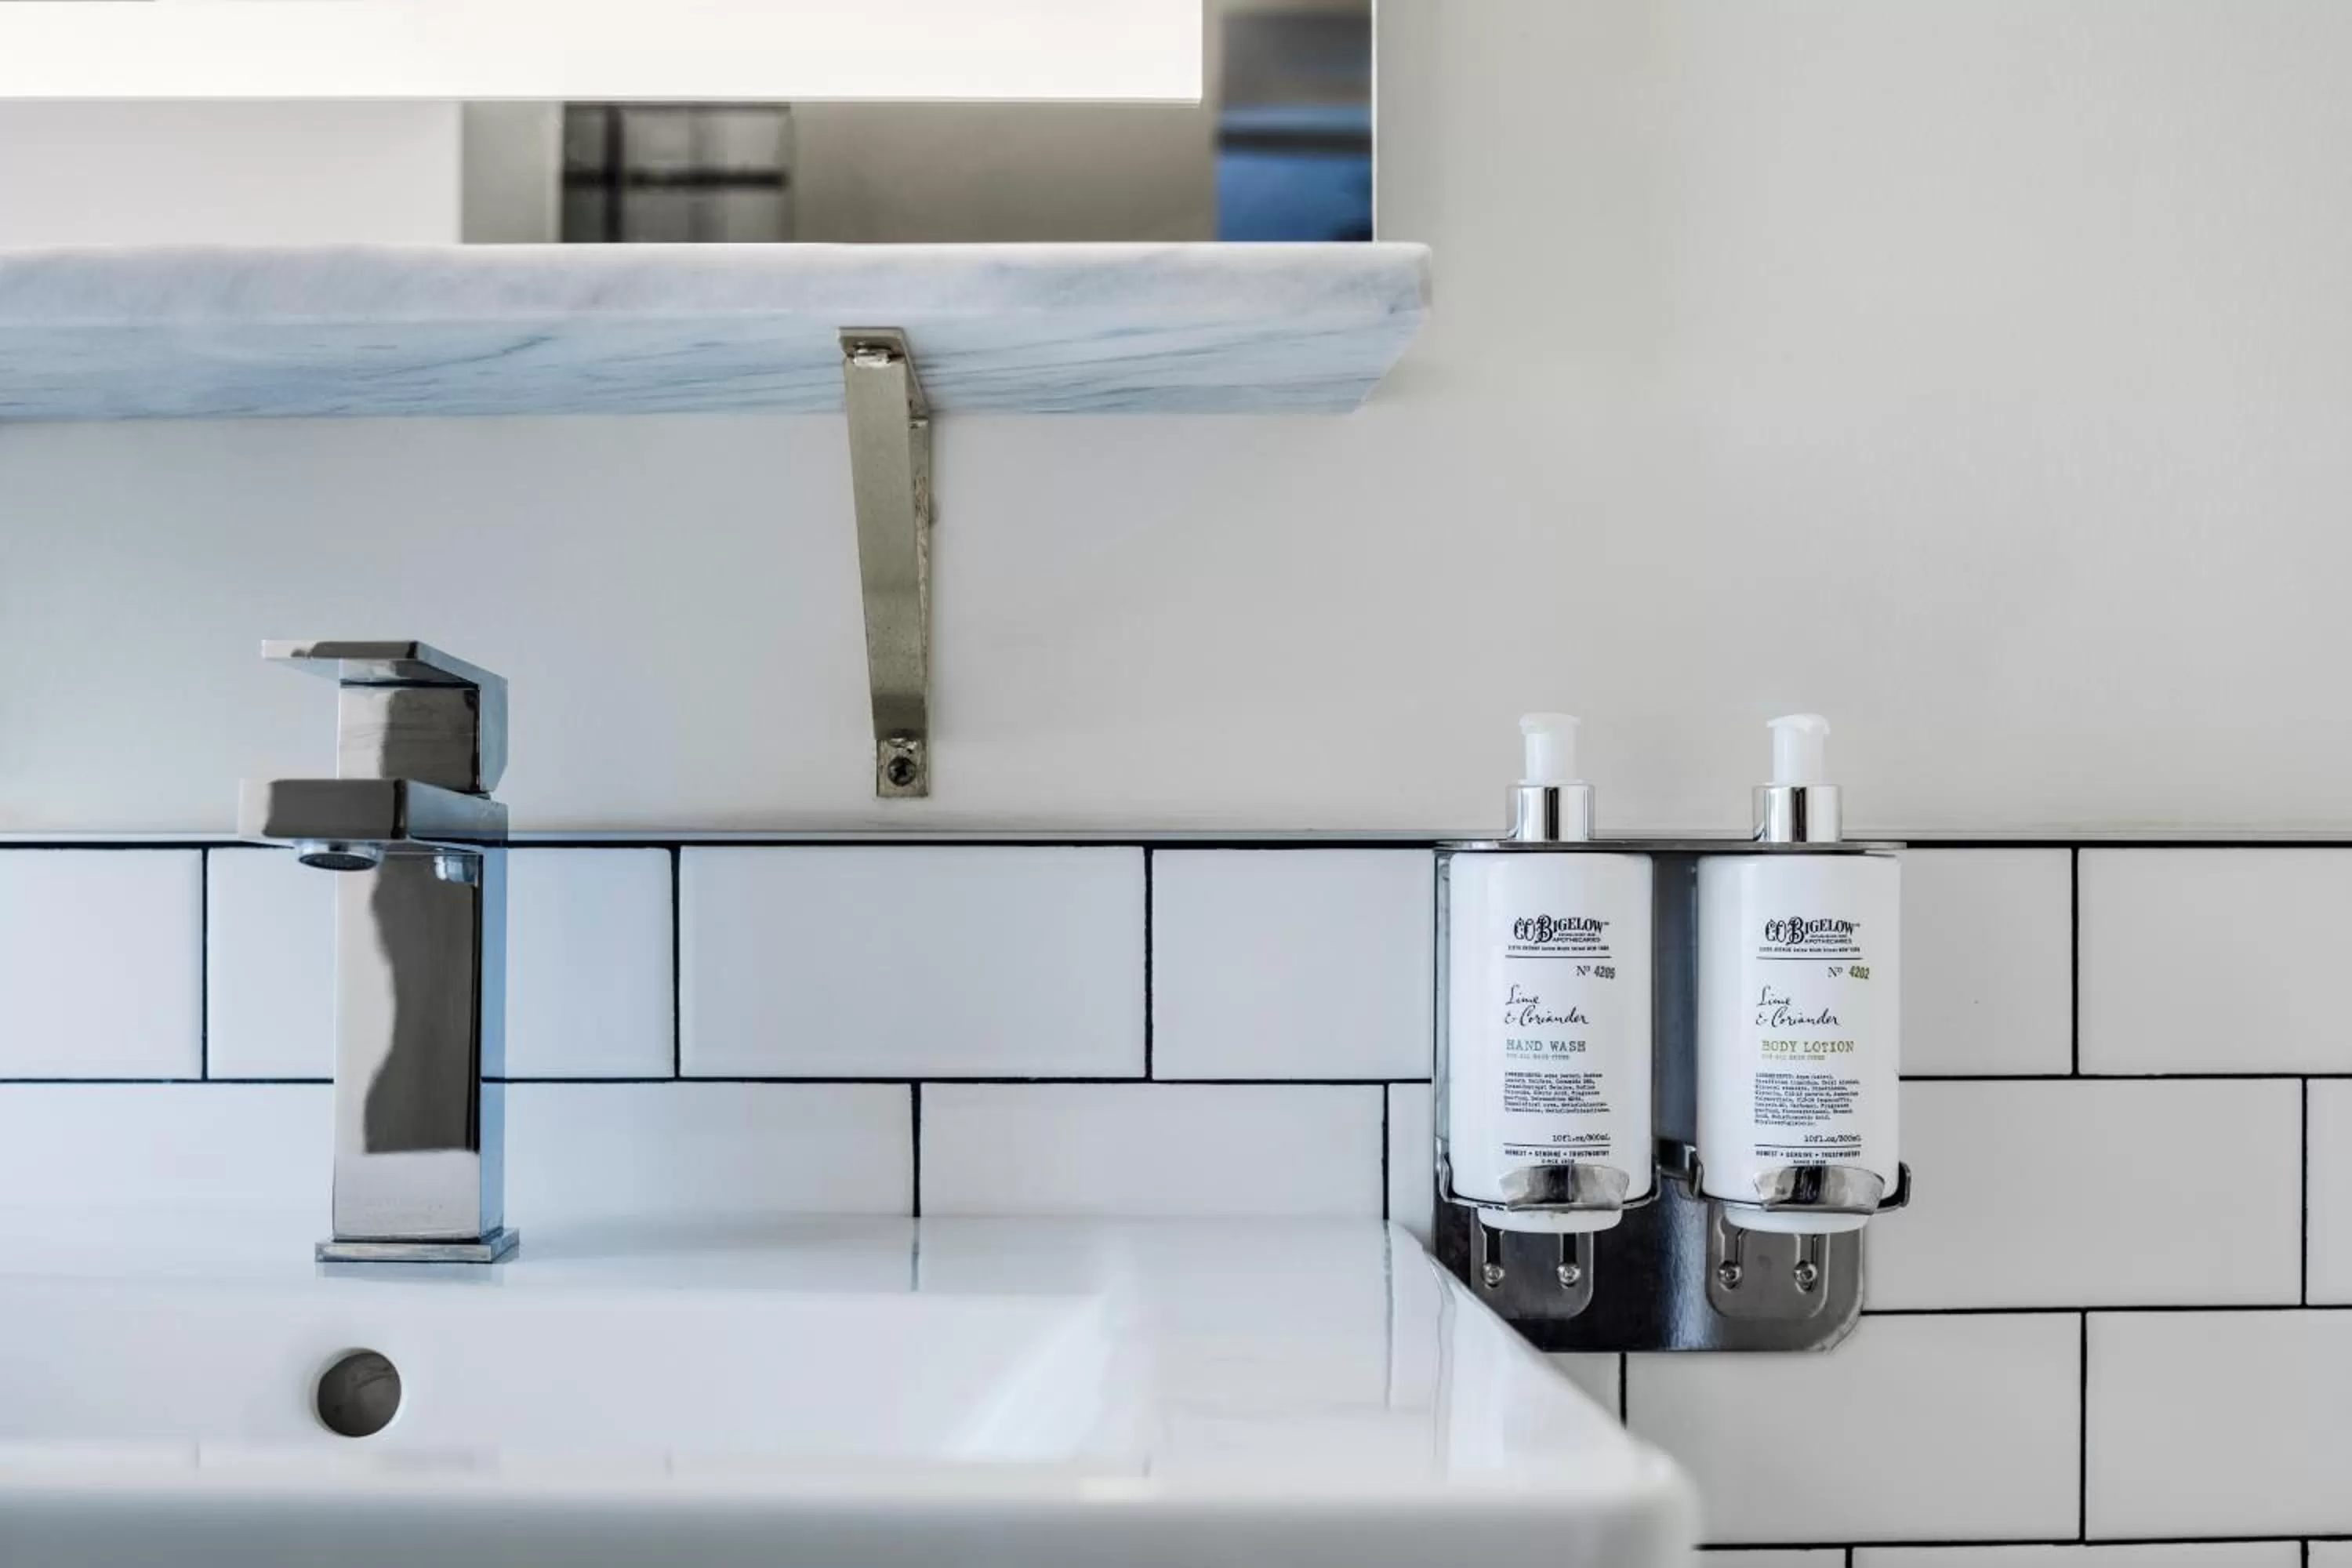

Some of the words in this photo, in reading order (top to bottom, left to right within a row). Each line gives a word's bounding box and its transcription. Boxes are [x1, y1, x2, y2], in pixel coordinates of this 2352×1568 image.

[1849, 965, 1870, 979] 4202
[1504, 984, 1540, 1005] Lime
[1755, 985, 1791, 1007] Lime
[1519, 1004, 1590, 1026] Coriander
[1771, 1006, 1842, 1028] Coriander
[1505, 1039, 1544, 1051] HAND
[1549, 1040, 1586, 1052] WASH
[1762, 1040, 1798, 1052] BODY
[1803, 1040, 1855, 1053] LOTION
